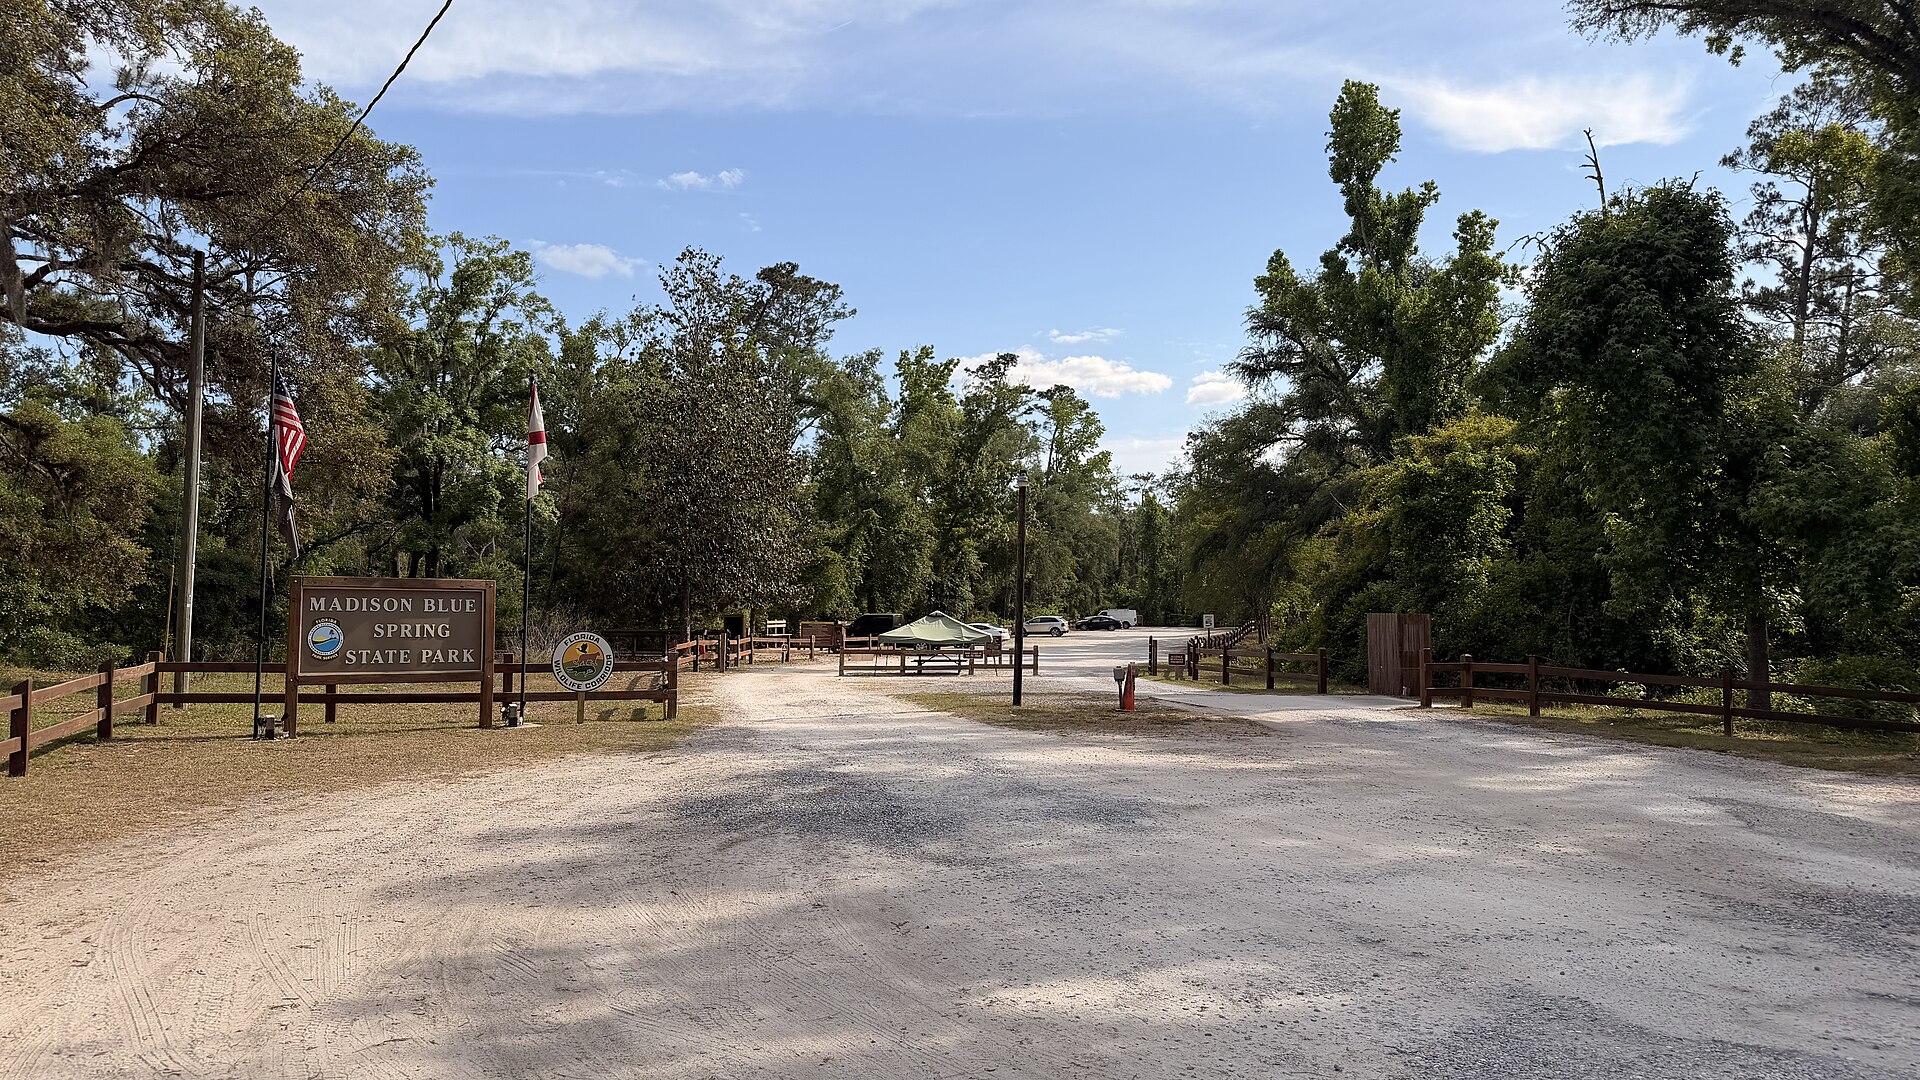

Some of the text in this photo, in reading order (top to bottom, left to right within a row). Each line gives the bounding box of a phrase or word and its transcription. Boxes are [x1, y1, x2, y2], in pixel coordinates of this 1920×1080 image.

[309, 597, 476, 613] MADISON BLUE
[373, 623, 451, 638] SPRING
[563, 633, 600, 647] FLORIDA
[345, 649, 475, 665] STATE PARK
[554, 654, 613, 690] WILDLIFE CORRIDOR
